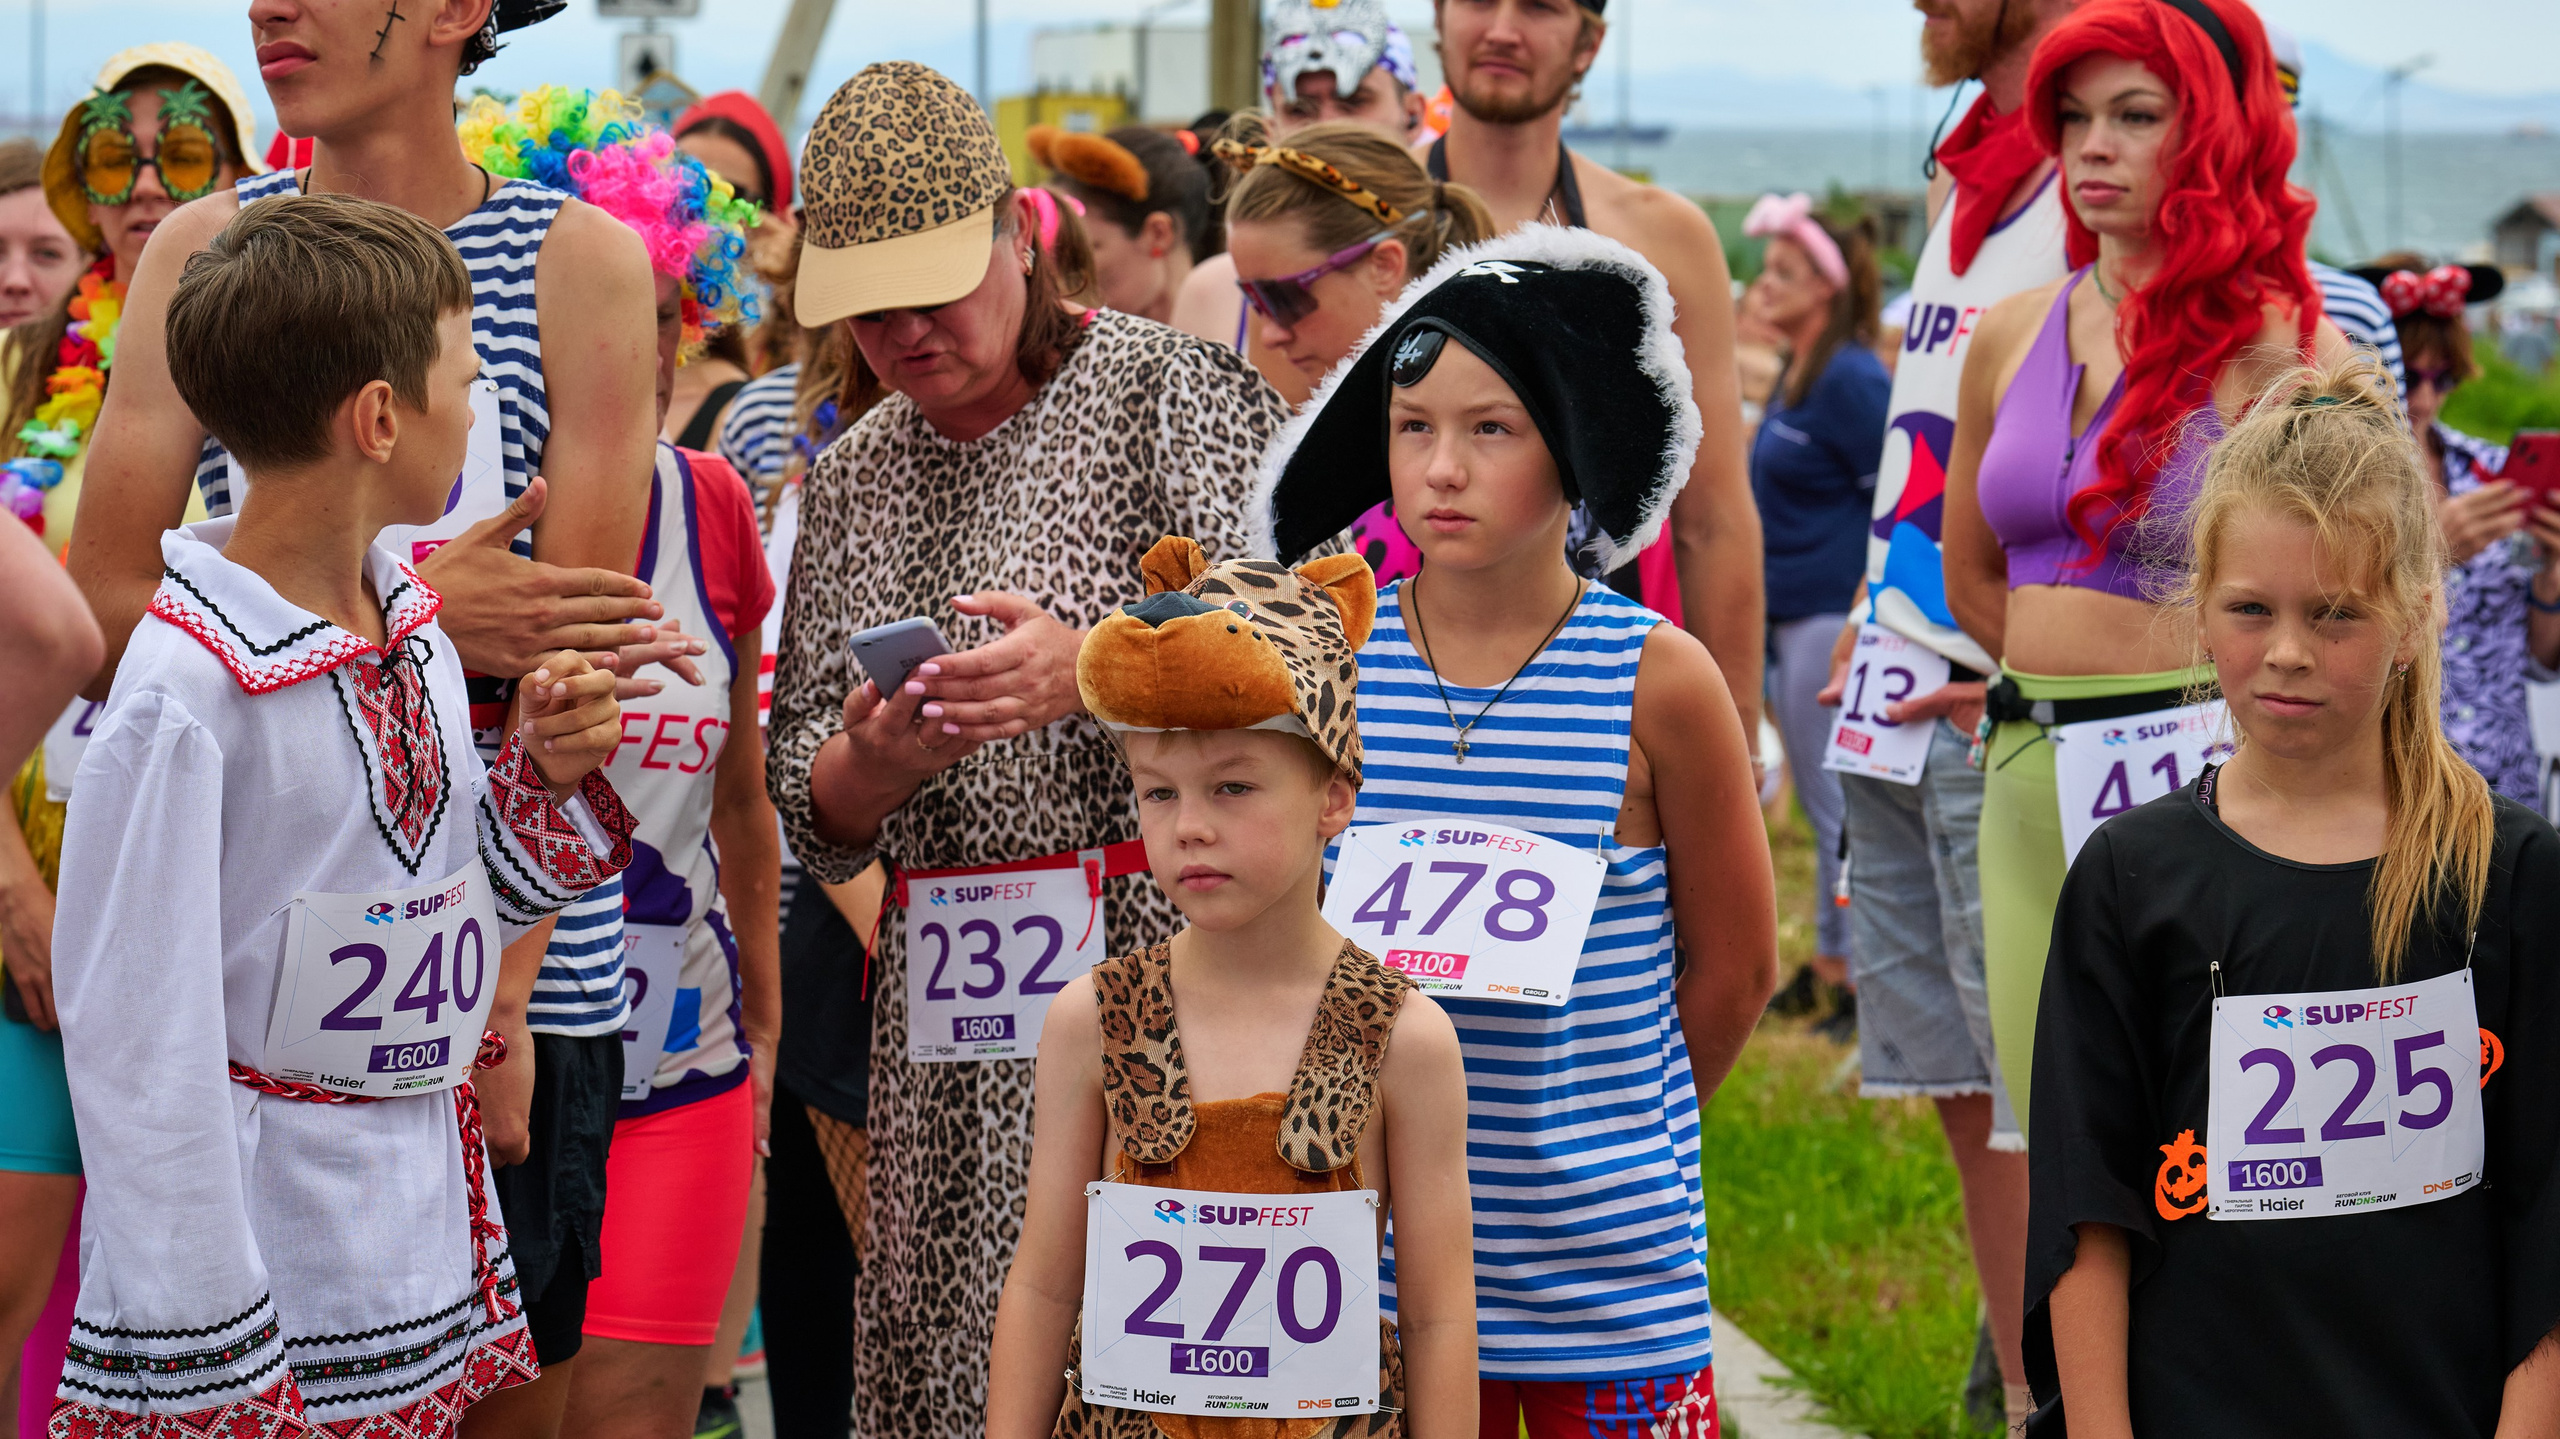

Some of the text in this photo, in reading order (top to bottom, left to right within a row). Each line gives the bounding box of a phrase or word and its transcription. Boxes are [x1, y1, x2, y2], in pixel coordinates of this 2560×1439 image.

[2137, 713, 2216, 740] SUPFEST
[2091, 743, 2239, 819] 41
[1436, 829, 1540, 855] SUPFEST
[405, 881, 467, 919] SUPFEST
[955, 882, 1037, 903] SUPFEST
[1352, 861, 1555, 942] 478
[920, 915, 1069, 1001] 232
[1395, 952, 1455, 975] 3100
[319, 917, 484, 1031] 240
[1487, 984, 1547, 997] DNS GROUP
[2305, 995, 2418, 1026] SUPFEST
[960, 1017, 1005, 1039] 1600
[382, 1042, 440, 1070] 1600
[935, 1044, 957, 1056] Haier
[320, 1074, 366, 1089] Haier
[392, 1076, 445, 1090] RUNDNSRUN
[2239, 1030, 2453, 1145] 225
[2241, 1161, 2307, 1188] 1600
[2423, 1174, 2472, 1195] DNS GROUP
[2260, 1197, 2304, 1211] Haier
[2335, 1193, 2397, 1207] RUNDNSRUN
[1199, 1205, 1314, 1226] SUPFEST
[1124, 1240, 1342, 1343] 270
[1185, 1348, 1253, 1373] 1600
[1133, 1389, 1176, 1405] Haier
[1205, 1401, 1269, 1410] RUNDNSRUN
[1298, 1398, 1358, 1409] DNS GROUP
